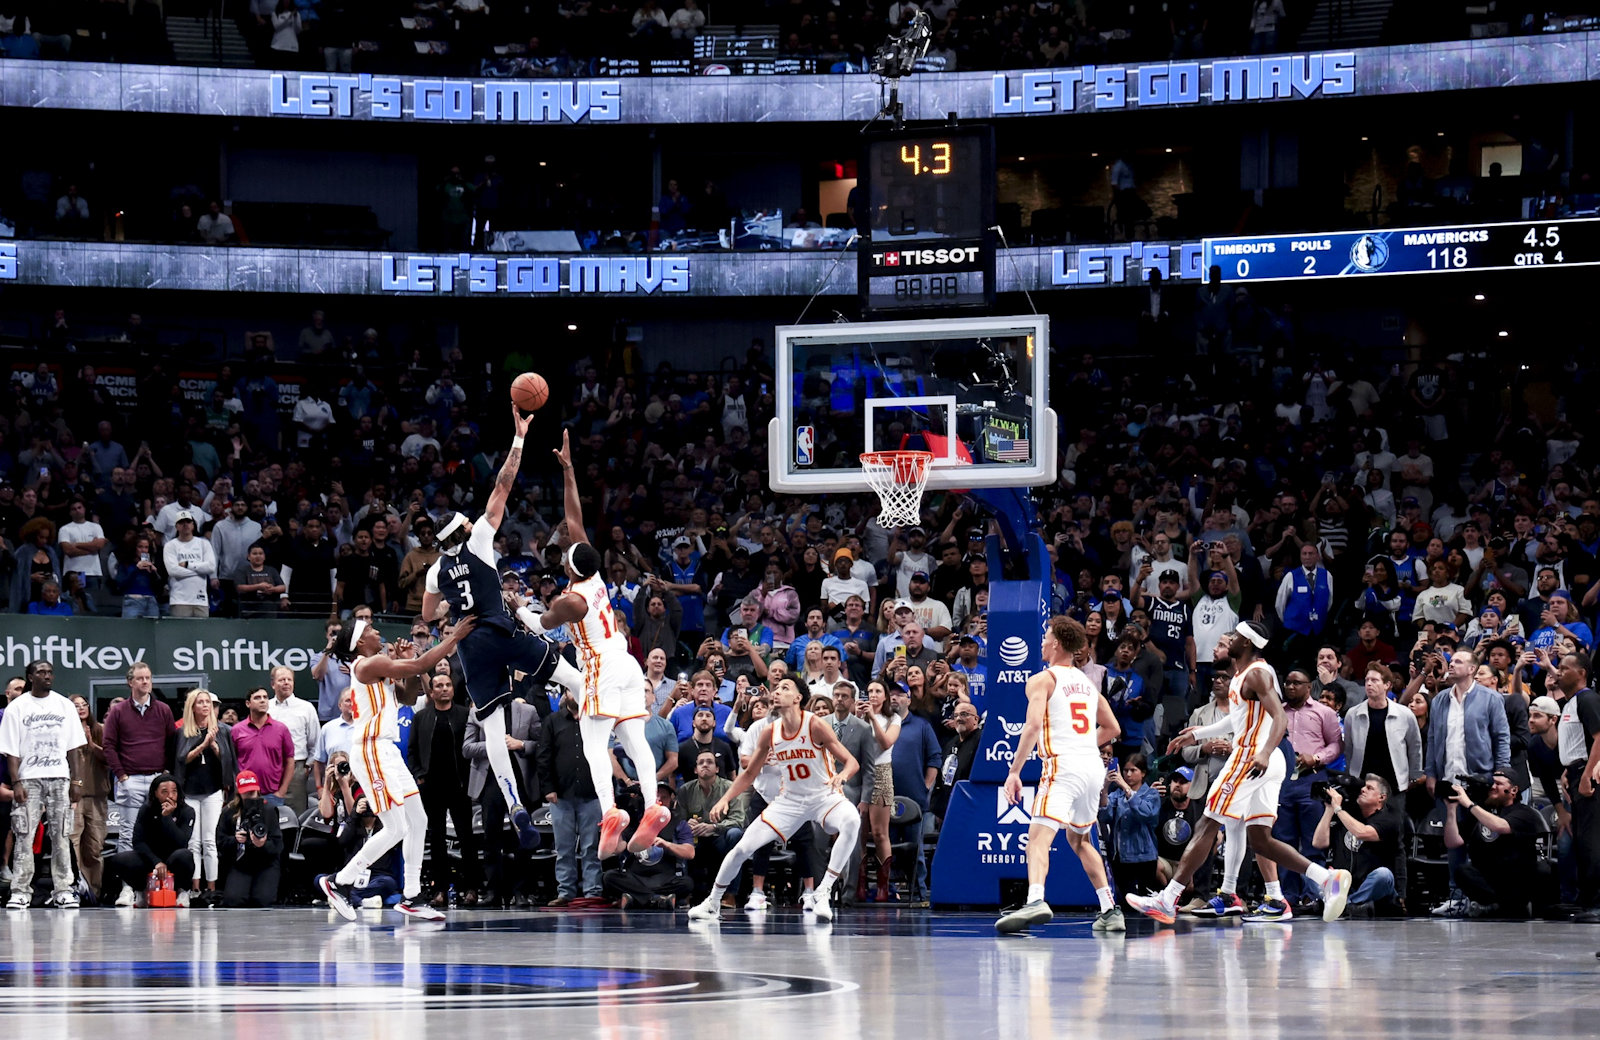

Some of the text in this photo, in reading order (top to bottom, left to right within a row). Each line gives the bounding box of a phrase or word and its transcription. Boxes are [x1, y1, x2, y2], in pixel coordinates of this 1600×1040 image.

[993, 52, 1355, 114] LET'S GO MAVS
[270, 74, 621, 124] LET'S GO MAVS
[901, 142, 952, 176] 4.3
[1291, 239, 1331, 252] FOULS
[1404, 229, 1489, 247] MAVERICKS
[1523, 227, 1560, 248] 4.5
[901, 247, 979, 265] TISSOT
[1214, 243, 1276, 255] TIMEOUTS
[1051, 242, 1169, 285] LET'S
[1303, 256, 1316, 274] 2
[1427, 248, 1467, 269] 118
[1514, 251, 1563, 267] QTR 4
[381, 253, 689, 294] LET'S GO MAVS
[1237, 259, 1250, 277] 0
[95, 375, 136, 386] ACME
[449, 564, 472, 581] DAVIS
[458, 580, 476, 613] 3
[1153, 609, 1183, 624] MAVS
[1202, 614, 1216, 625] 31
[1167, 624, 1181, 639] 25
[997, 670, 1032, 683] AT&T
[970, 682, 986, 696] 77
[1062, 683, 1091, 697] DANIELS
[1070, 702, 1090, 734] 5
[787, 763, 811, 781] 10
[981, 854, 1015, 864] ENERGY
